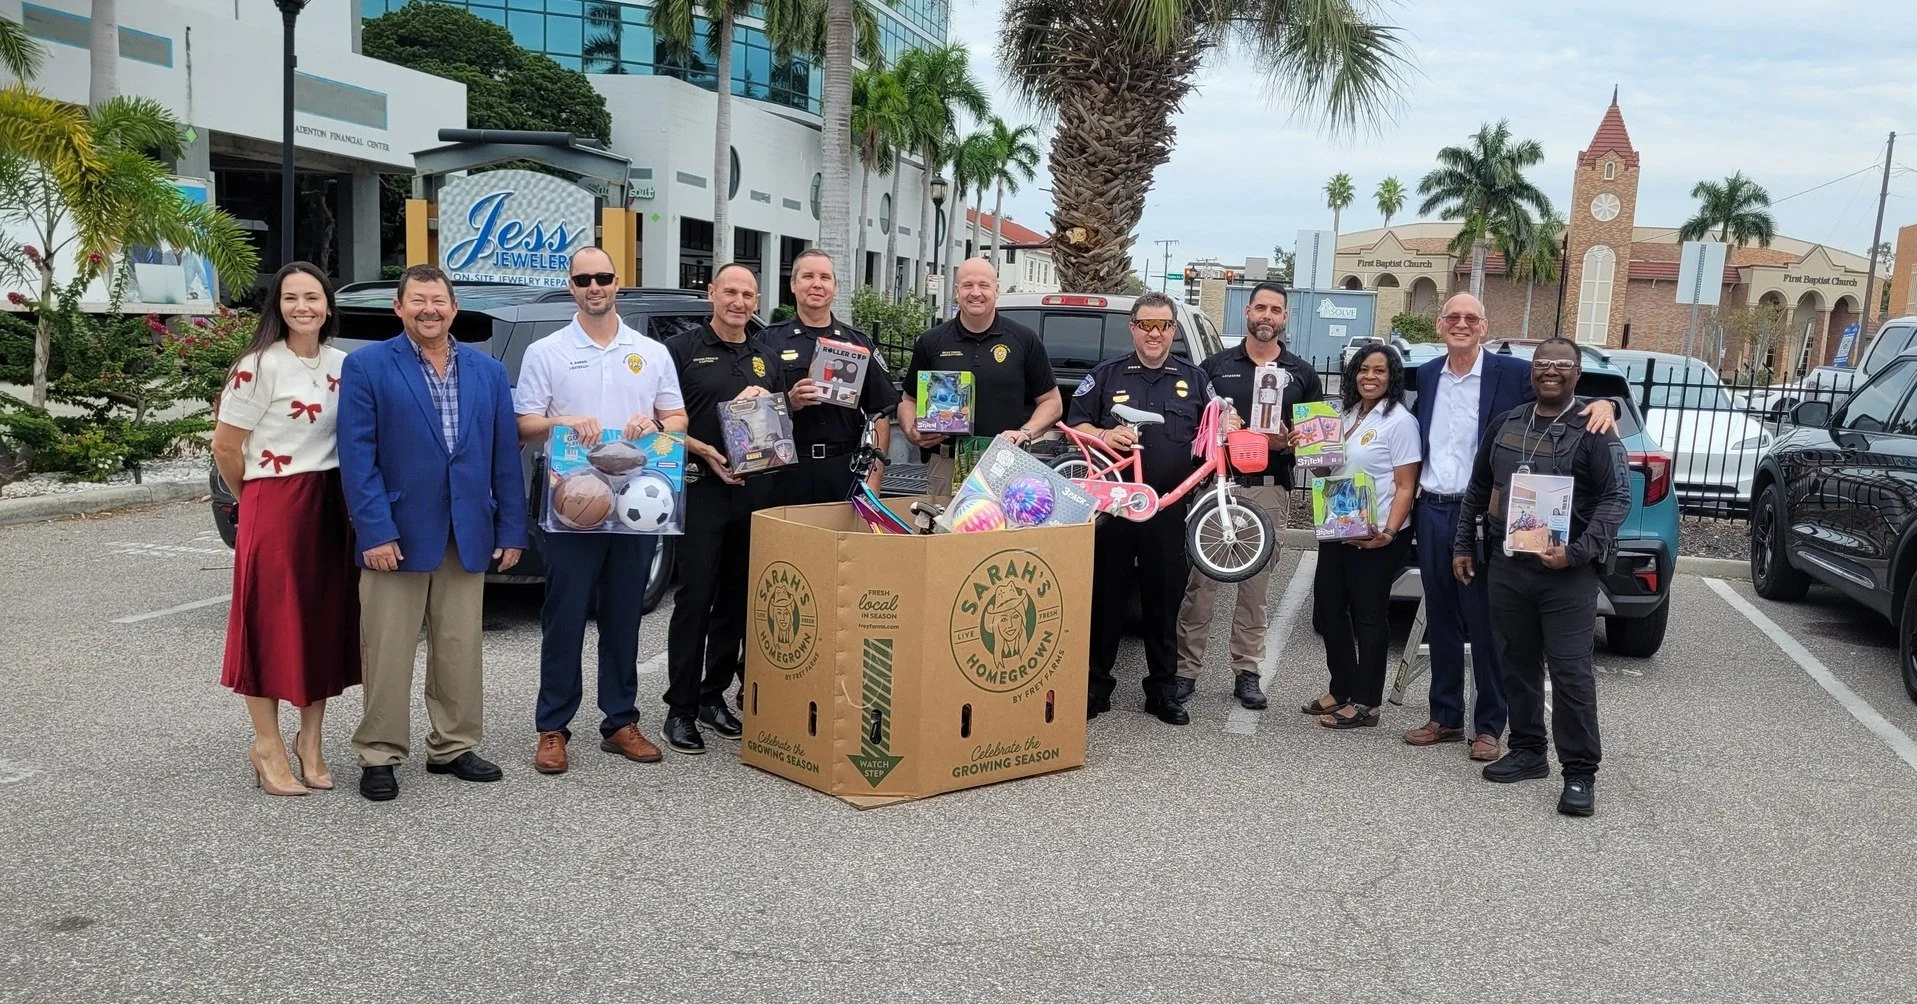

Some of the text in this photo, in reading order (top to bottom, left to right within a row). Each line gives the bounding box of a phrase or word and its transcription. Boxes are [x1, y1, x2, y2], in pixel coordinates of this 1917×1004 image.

[295, 125, 390, 151] ADENTON FINANCIAL CENTER
[446, 188, 586, 271] Jess
[492, 250, 571, 271] JEWELER
[1357, 259, 1432, 269] First Baptist Church
[453, 273, 495, 282] ON-SITE
[544, 277, 570, 288] REPA
[1783, 274, 1857, 287] First Baptist Church
[1331, 309, 1356, 318] SOLVE
[822, 346, 850, 358] ROLLER
[851, 352, 867, 361] CUP
[760, 569, 810, 607] SARAH'S
[962, 558, 1051, 616] SARAH'S
[858, 593, 899, 611] local
[858, 622, 900, 630] freyfarms.com
[957, 609, 1058, 640] LIVE FRESH
[760, 630, 813, 664] HOMEGROWN
[966, 630, 1054, 685] HOMEGROWN
[792, 669, 806, 680] FREY
[805, 651, 820, 672] FARMS
[1012, 649, 1065, 704] BY FREY FARMS
[758, 730, 806, 756] Celebrate the
[971, 735, 1041, 762] Celebrate the
[747, 740, 819, 774] GROWING SEASON
[860, 760, 889, 768] WATCH
[952, 747, 1060, 778] GROWING SEASON
[864, 769, 885, 777] STEP
